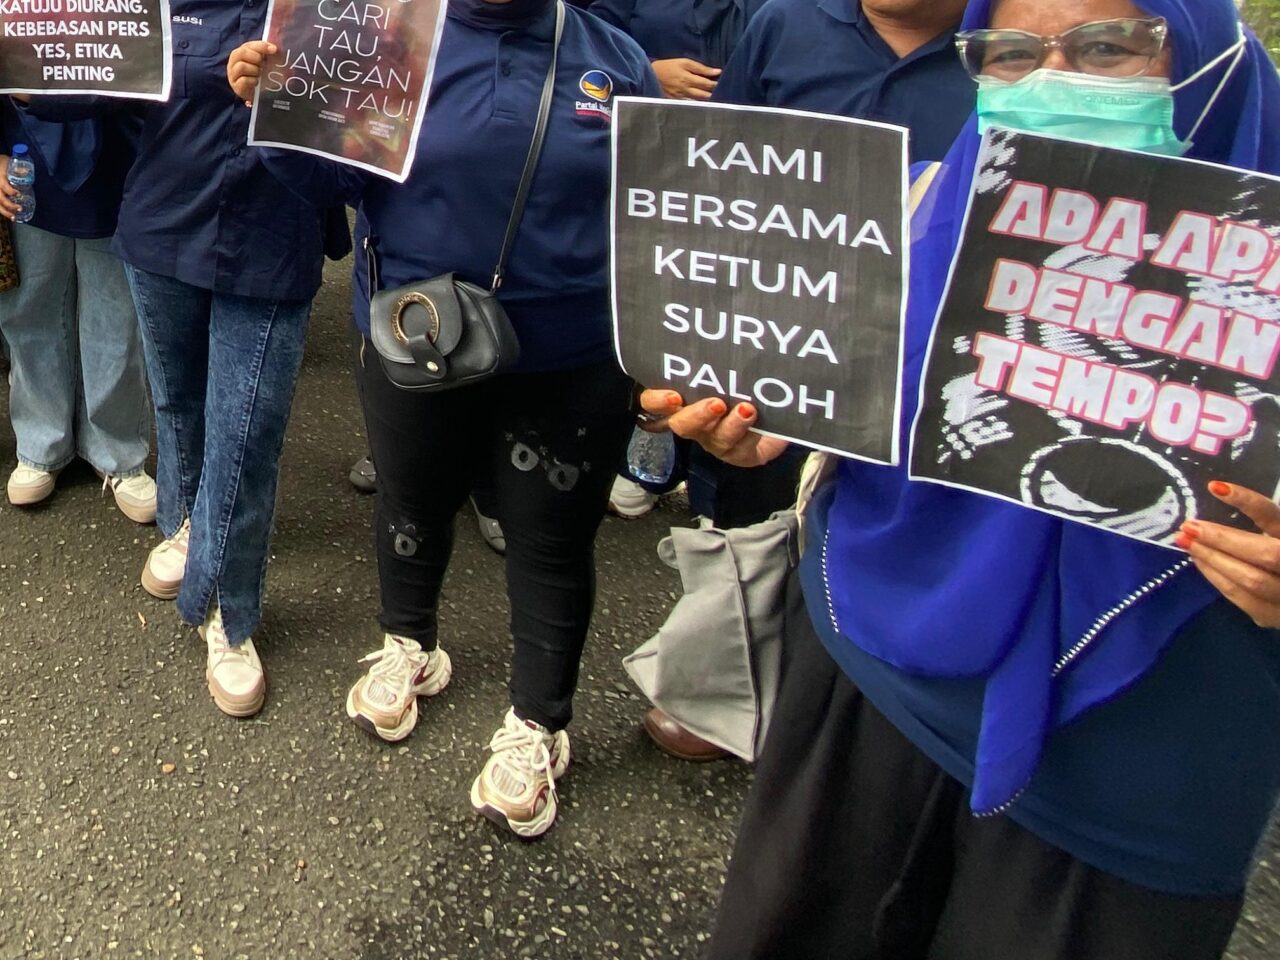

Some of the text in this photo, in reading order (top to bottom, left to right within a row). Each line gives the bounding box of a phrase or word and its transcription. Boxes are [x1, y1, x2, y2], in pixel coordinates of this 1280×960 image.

[4, 21, 149, 37] KEBEBASAN PERS
[173, 16, 202, 25] SUSI
[314, 25, 382, 62] TAU,
[32, 43, 123, 60] YES, ETIKA
[43, 66, 115, 81] PENTING
[276, 49, 411, 93] JANGAN
[265, 72, 330, 103] SOK
[341, 87, 412, 121] TAU!
[688, 137, 822, 182] KAMI
[628, 188, 892, 255] BERSAMA
[988, 180, 1147, 260] ADA
[654, 245, 837, 303] KETUM
[662, 303, 839, 364] SURYA
[983, 258, 1280, 380] DENGAN
[663, 353, 834, 420] PALOH
[972, 331, 1252, 455] TEMPO?
